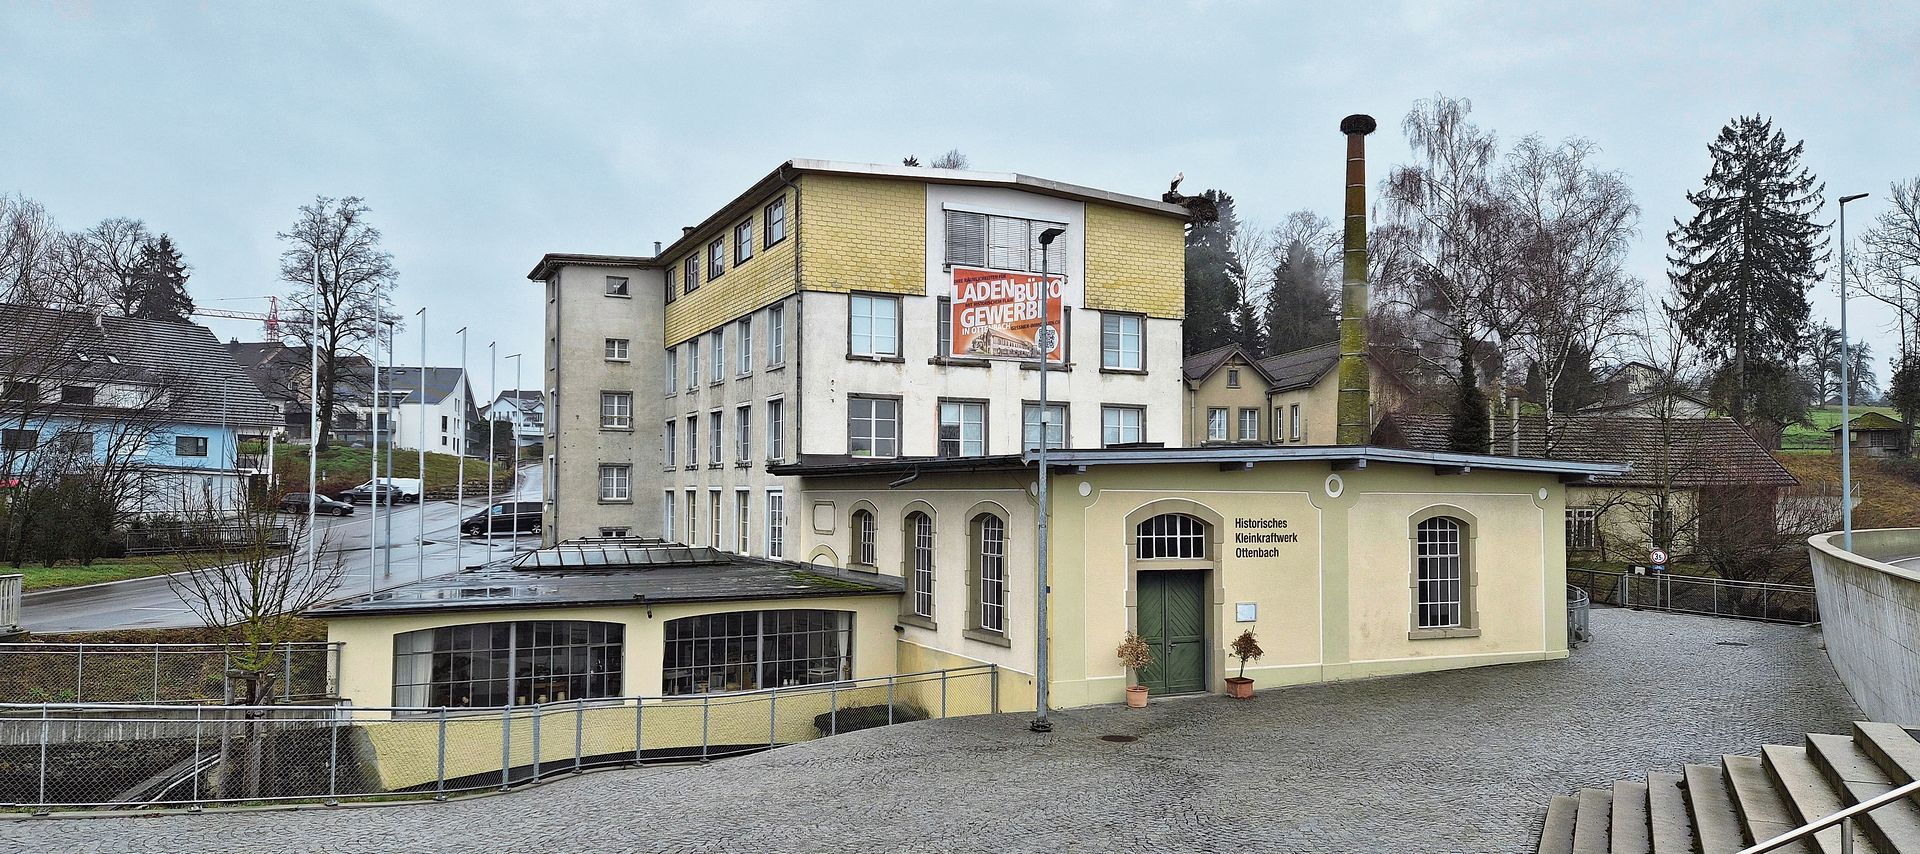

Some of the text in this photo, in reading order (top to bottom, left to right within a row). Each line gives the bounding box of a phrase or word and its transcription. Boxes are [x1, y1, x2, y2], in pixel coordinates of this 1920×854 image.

[953, 278, 1062, 304] LADEN BÜRO
[962, 328, 970, 336] IN
[1235, 518, 1288, 529] Historisches
[1235, 532, 1298, 543] Kleinkraftwerk
[1235, 547, 1279, 558] Ottenbach
